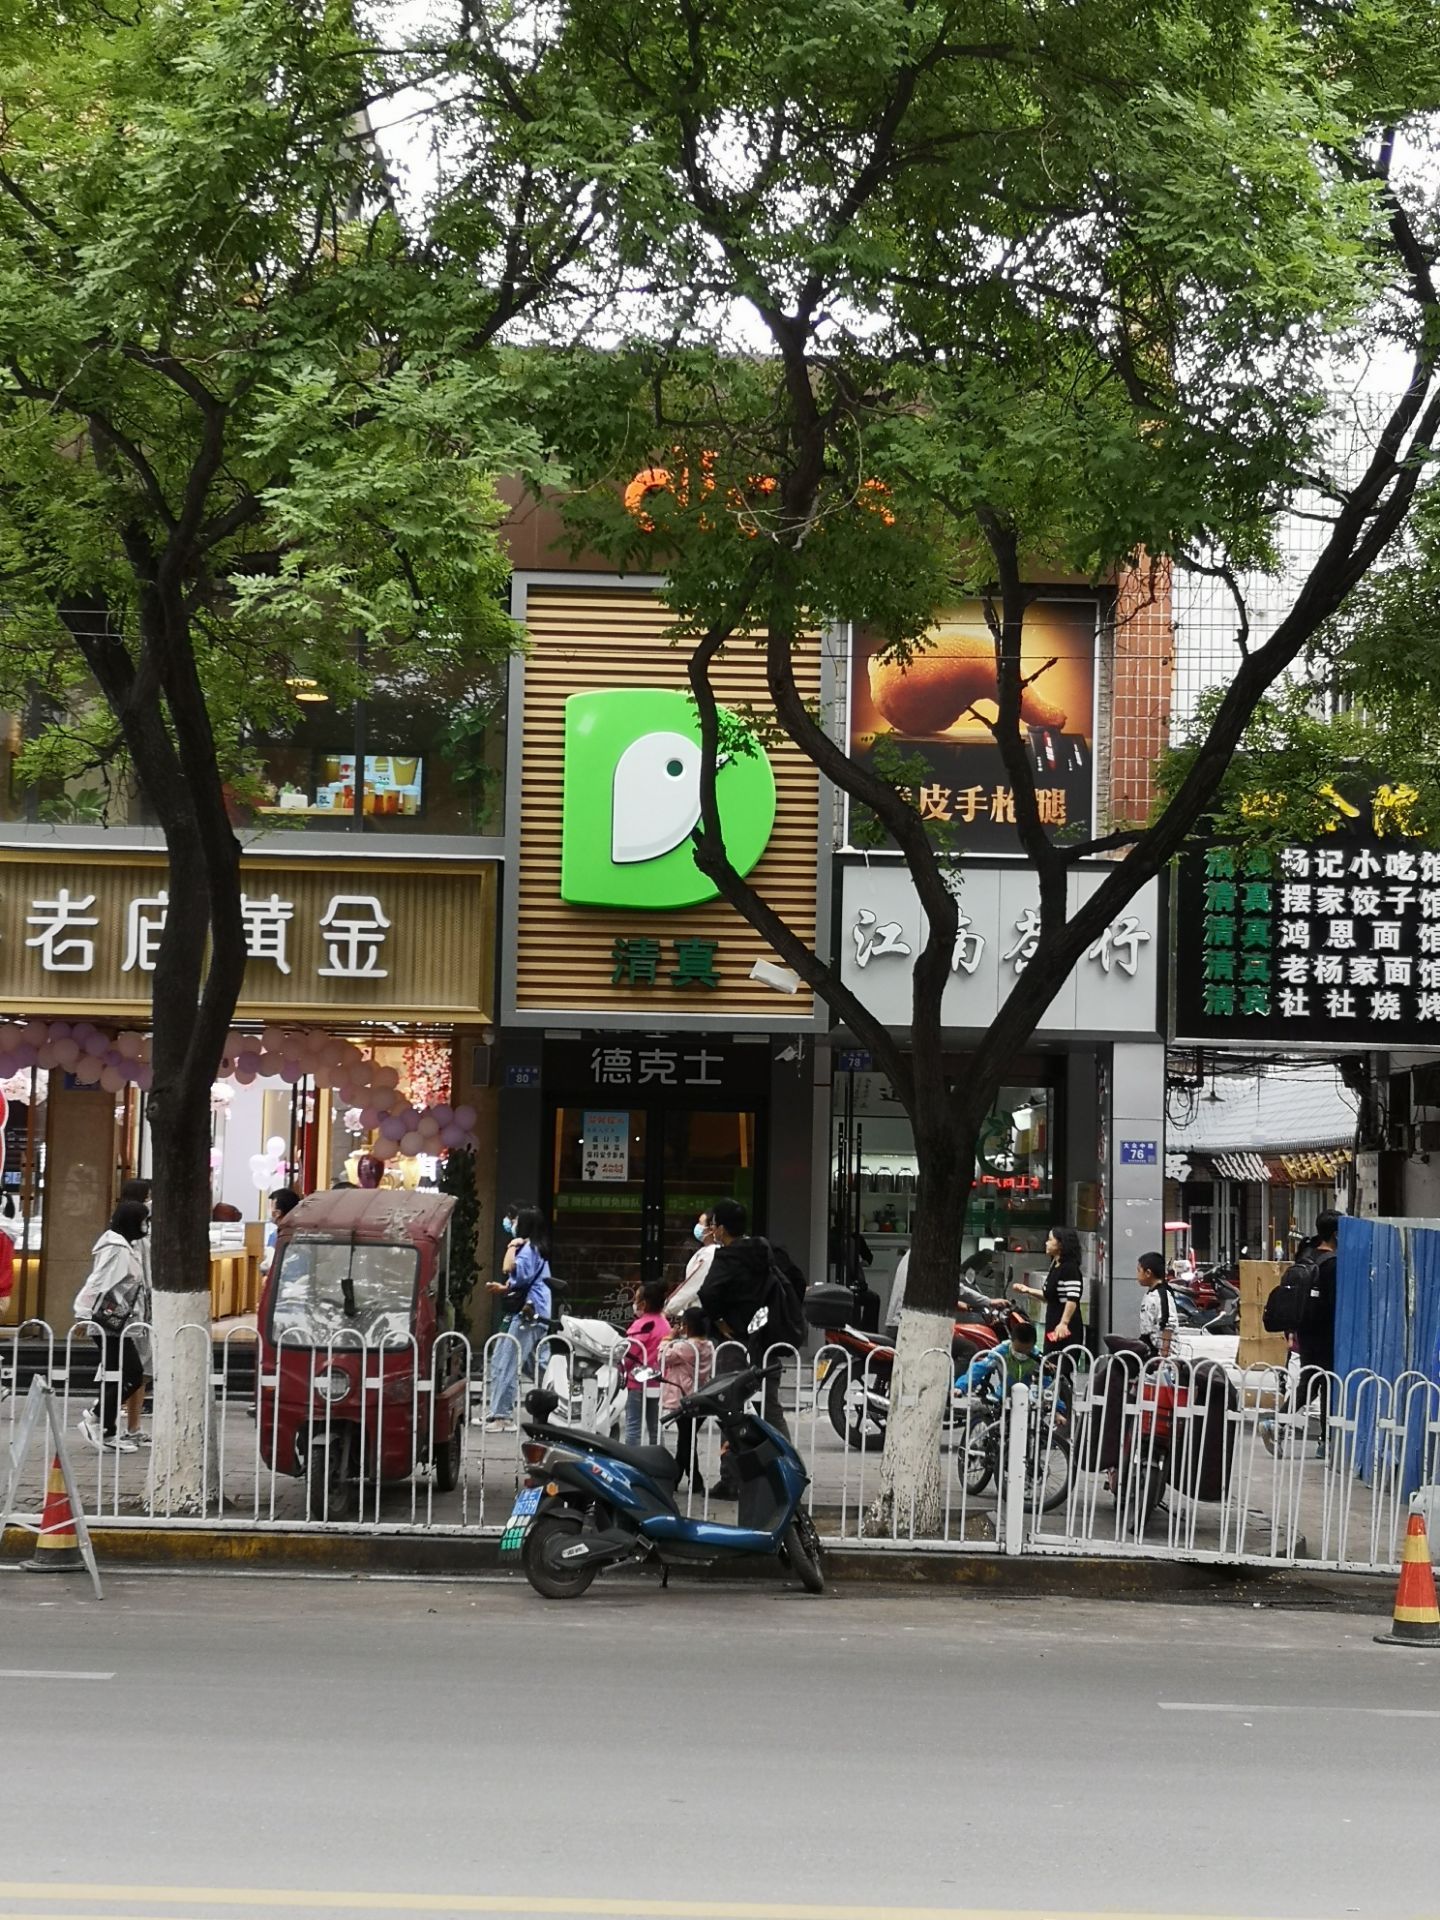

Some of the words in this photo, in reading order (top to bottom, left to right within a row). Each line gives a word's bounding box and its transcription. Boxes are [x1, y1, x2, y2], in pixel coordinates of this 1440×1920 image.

[894, 783, 1067, 826] 皮手枪腿
[1202, 880, 1272, 914] 清真
[1202, 914, 1272, 948] 清真
[1278, 919, 1440, 954] 鸿恩面馆
[611, 937, 721, 988] 清真
[1202, 949, 1272, 983] 清真
[1279, 955, 1440, 988] 老杨家面馆
[1202, 983, 1272, 1017] 清真
[516, 1073, 529, 1083] 80
[591, 1048, 724, 1085] 德克士
[1130, 1149, 1144, 1159] 76
